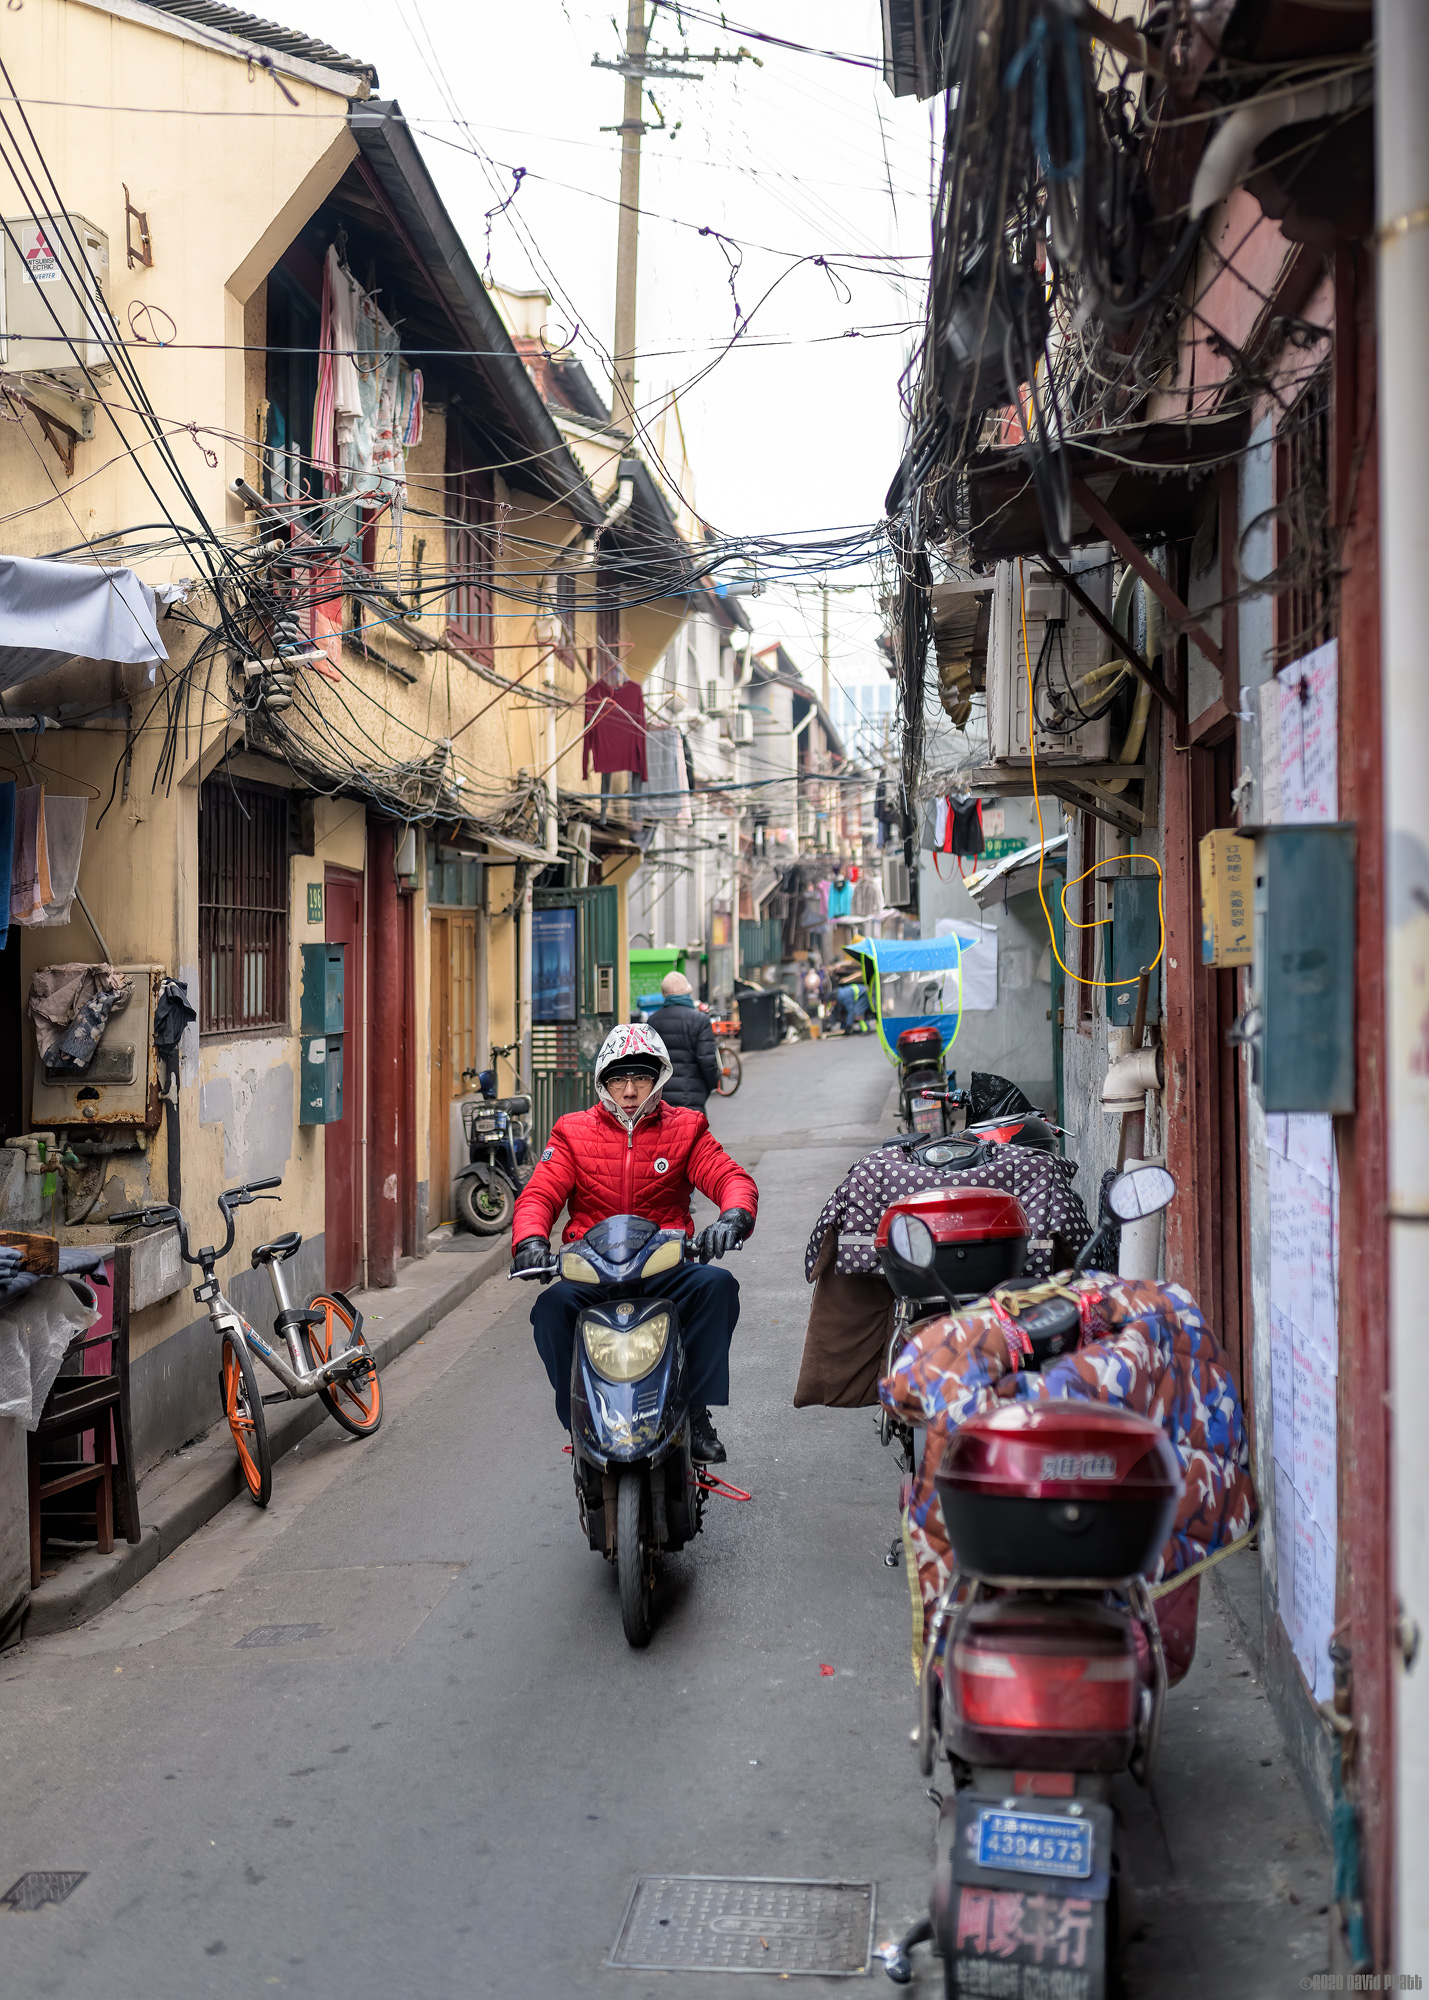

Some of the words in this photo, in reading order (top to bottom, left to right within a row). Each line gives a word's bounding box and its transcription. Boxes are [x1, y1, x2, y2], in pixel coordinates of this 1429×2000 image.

[310, 889, 321, 909] 196
[1039, 1455, 1117, 1481] 雅迪
[991, 1818, 1018, 1834] 上海
[987, 1834, 1083, 1862] 4394573
